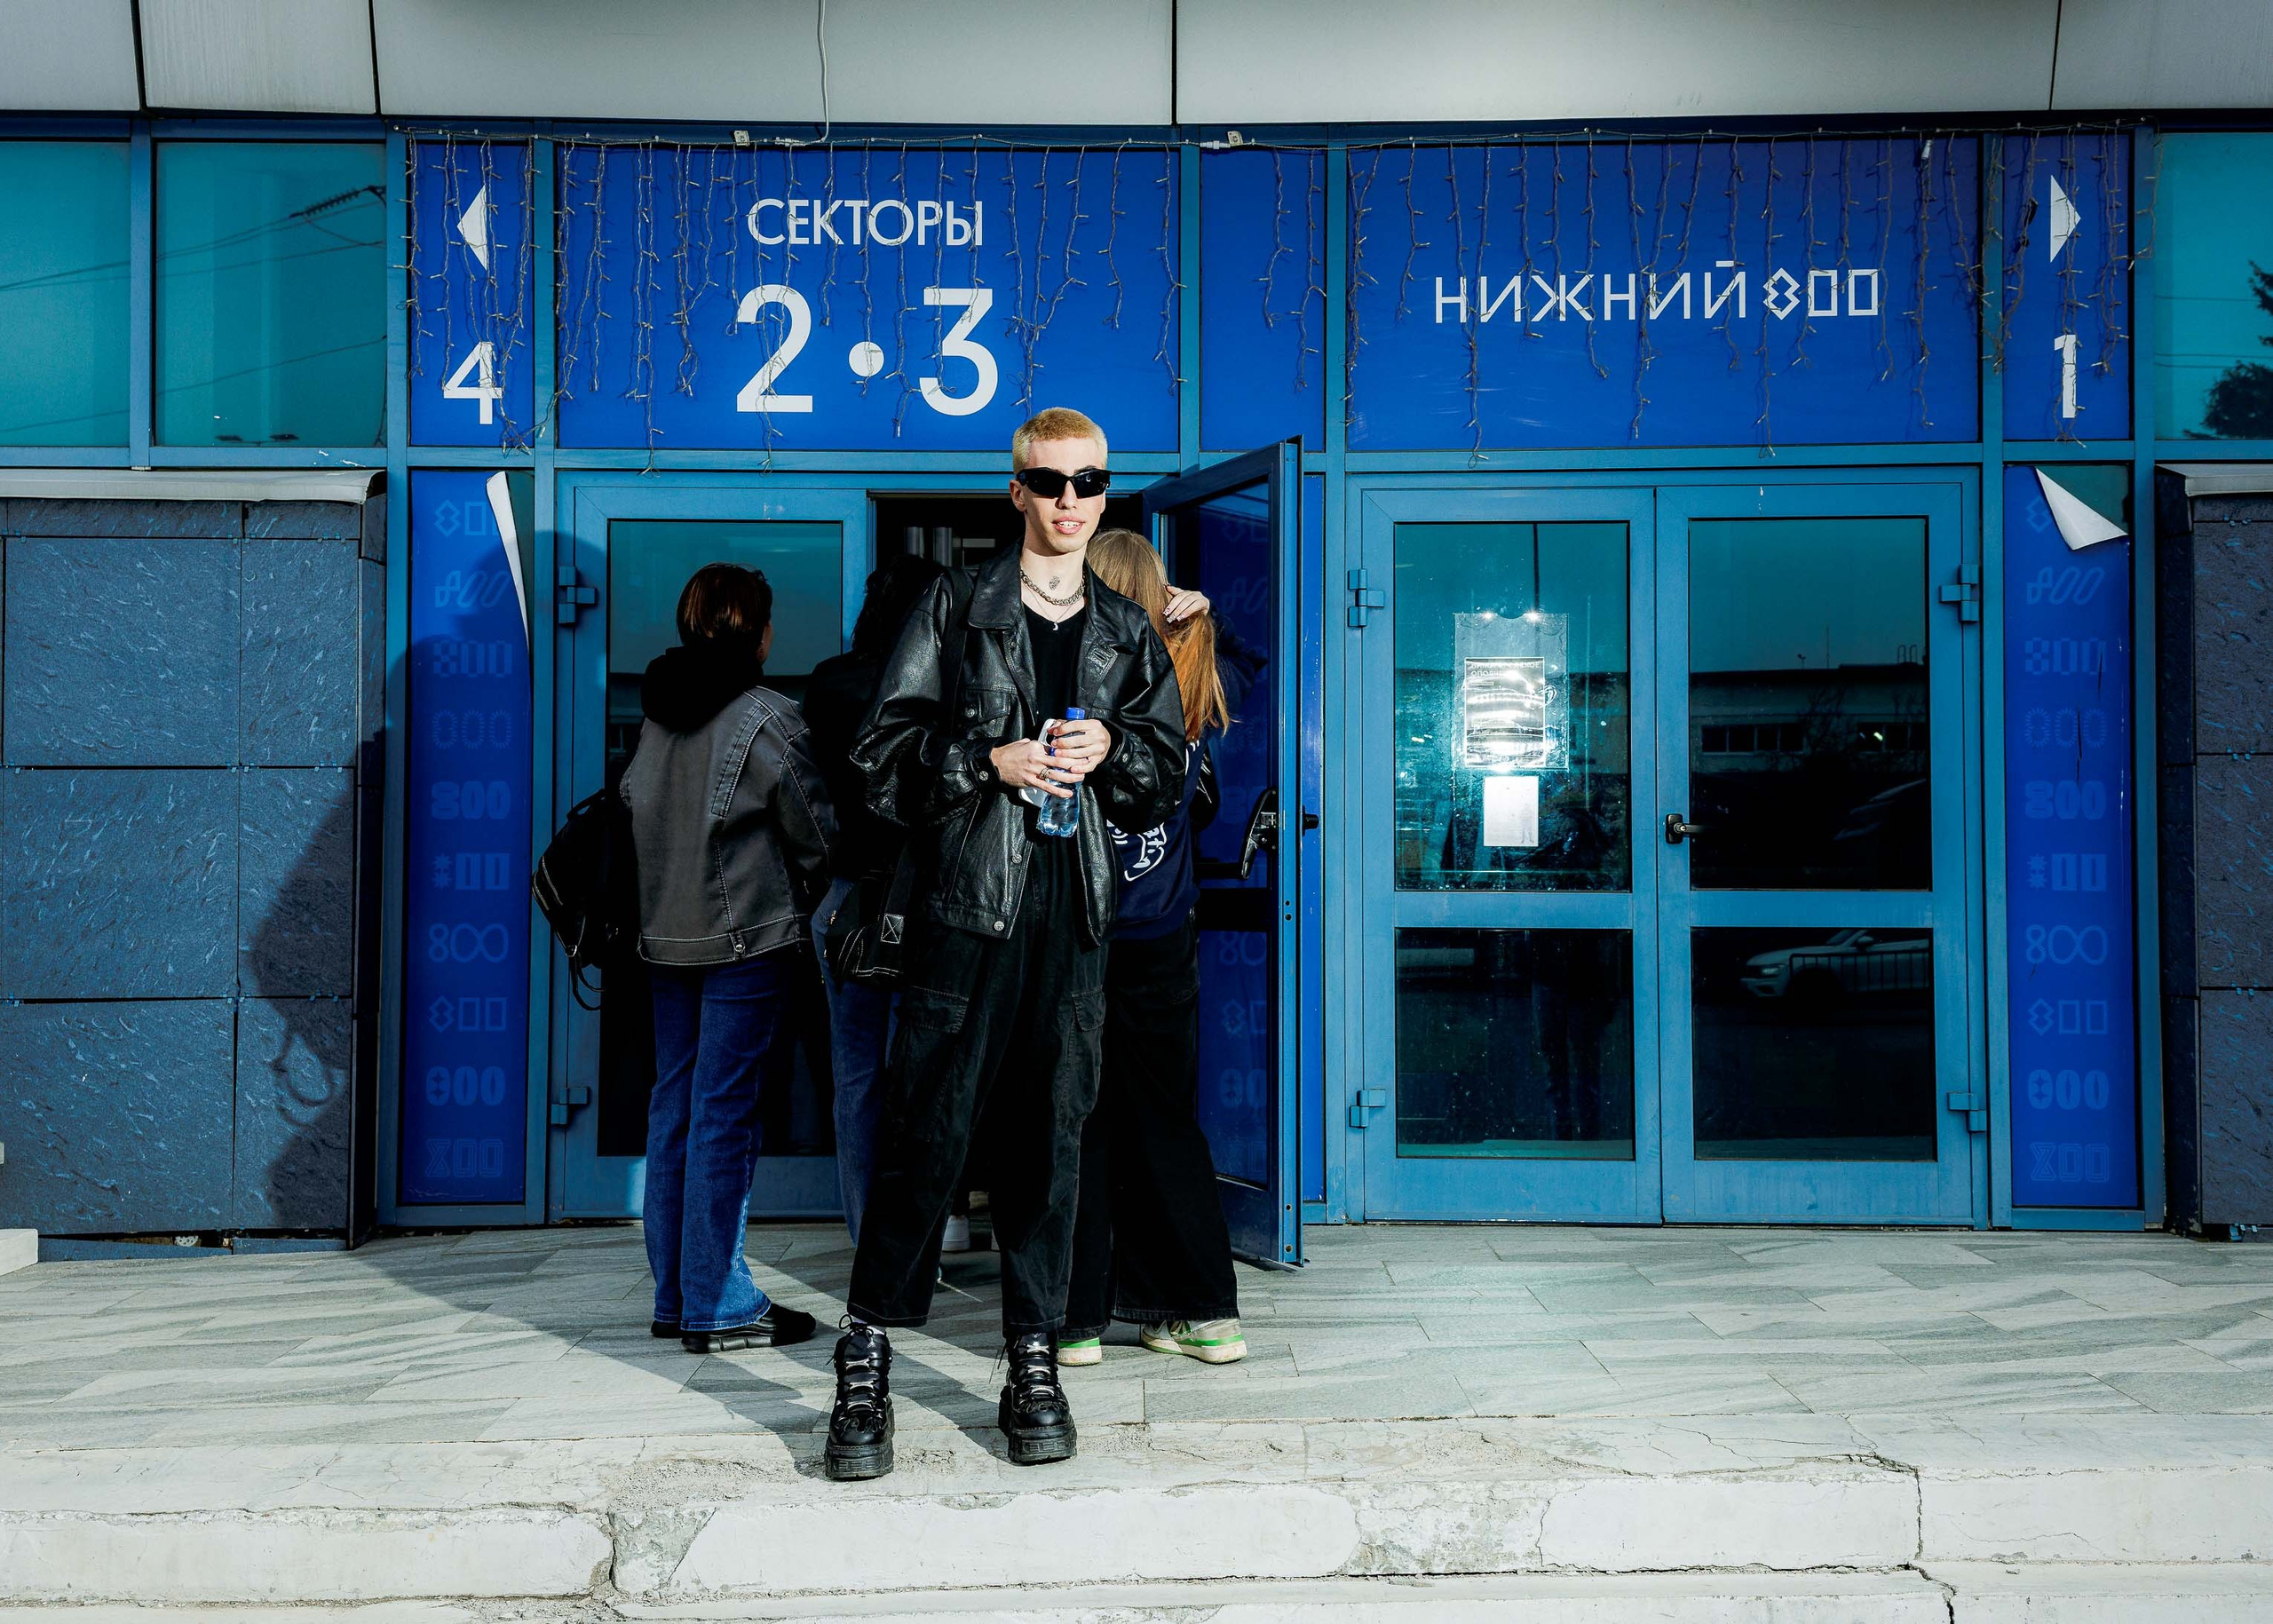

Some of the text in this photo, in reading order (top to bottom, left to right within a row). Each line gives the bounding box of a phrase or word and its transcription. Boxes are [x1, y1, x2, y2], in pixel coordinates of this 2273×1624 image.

[746, 198, 984, 246] СЕКТОРЫ
[1435, 260, 1880, 324] НИЖНИЙ 800
[442, 341, 503, 424] 4
[2054, 334, 2077, 418] 1
